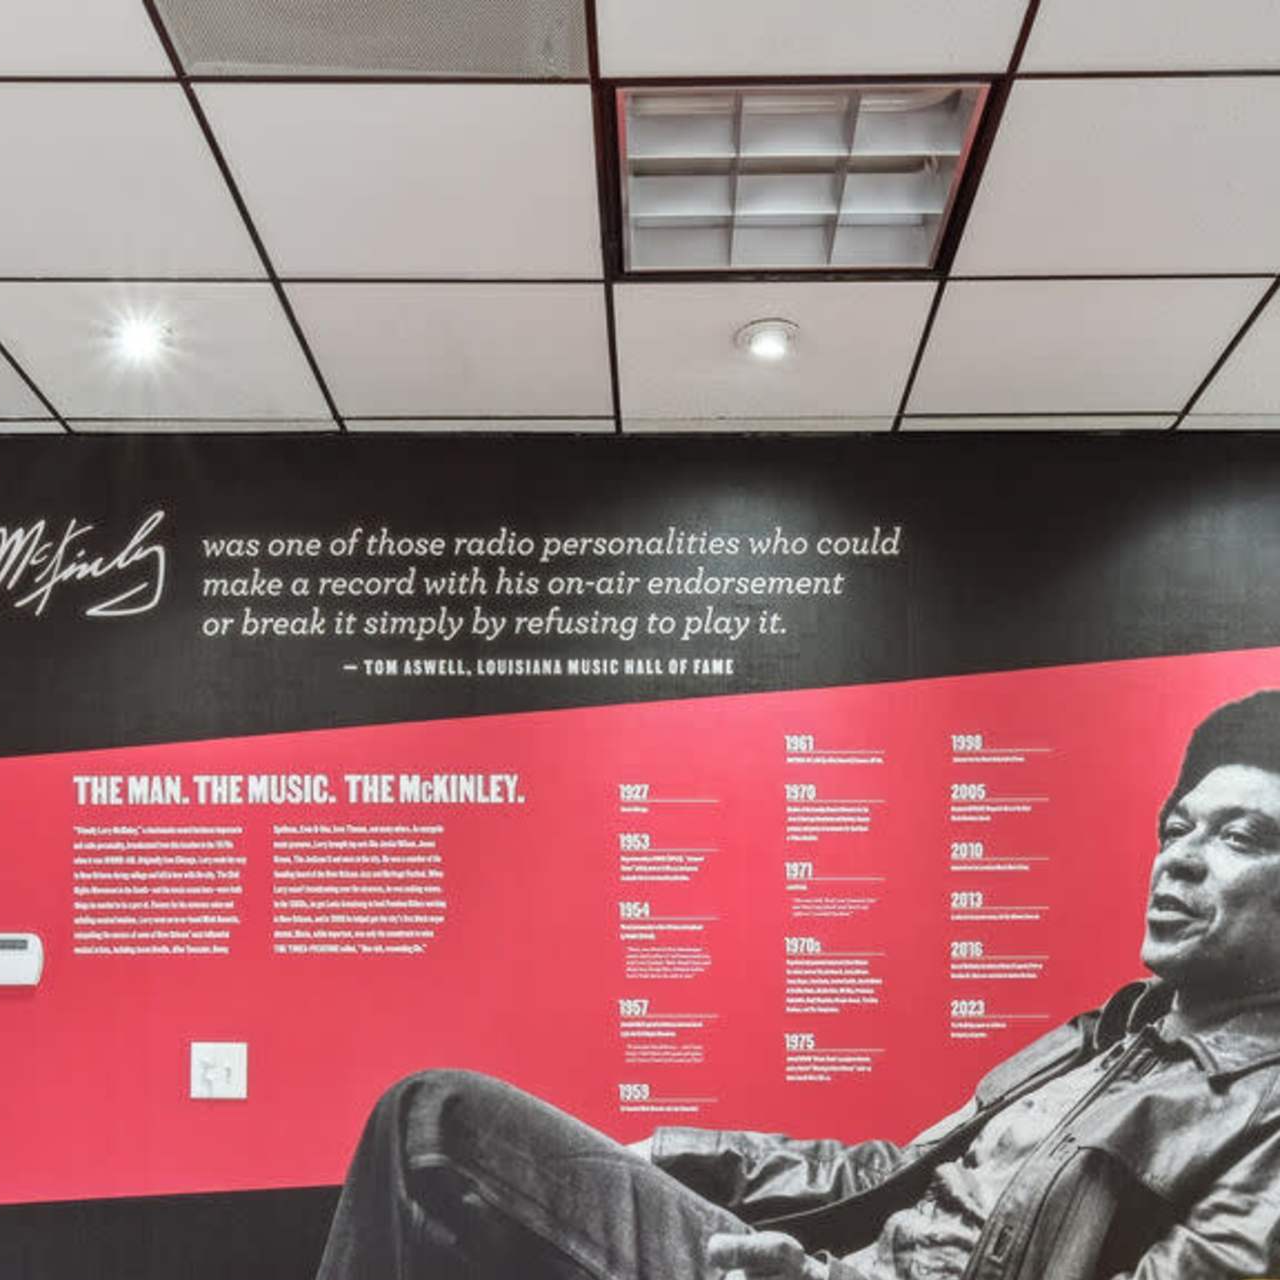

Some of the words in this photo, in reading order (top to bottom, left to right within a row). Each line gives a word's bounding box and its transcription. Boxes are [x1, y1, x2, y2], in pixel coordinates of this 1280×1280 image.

[203, 536, 259, 557] was
[268, 536, 321, 557] one
[329, 527, 364, 557] of
[366, 527, 447, 557] those
[454, 527, 535, 556] radio
[539, 527, 740, 562] personalities
[749, 527, 808, 556] who
[816, 527, 901, 556] could
[202, 567, 284, 597] make
[290, 576, 311, 597] a
[318, 567, 417, 597] record
[425, 567, 487, 596] with
[494, 567, 540, 596] his
[547, 570, 639, 596] on-air
[646, 567, 845, 596] endorsement
[202, 613, 235, 637] or
[241, 607, 326, 637] break
[333, 610, 357, 636] it
[363, 607, 463, 641] simply
[471, 606, 507, 641] by
[514, 606, 639, 641] refusing
[646, 611, 677, 635] to
[680, 606, 750, 641] play
[757, 609, 788, 636] it.
[363, 659, 399, 676] TOM
[403, 659, 473, 678] ASWELL,
[476, 658, 562, 675] LOUISIANA
[567, 658, 619, 675] MUSIC
[623, 658, 664, 675] HALL
[668, 658, 689, 675] OF
[692, 658, 735, 675] FAME
[73, 776, 123, 805] THE
[127, 775, 190, 805] MAN.
[192, 775, 244, 804] THE
[247, 774, 337, 804] MUSIC.
[345, 774, 395, 803] THE
[399, 774, 526, 803] McKINLEY.
[619, 784, 650, 800] 1927
[784, 784, 817, 800] 1970
[950, 784, 986, 799] 2005
[619, 833, 650, 850] 1953
[950, 842, 984, 859] 2010
[784, 862, 813, 879] 1971
[619, 902, 650, 918] 1954
[619, 999, 650, 1016] 1957
[950, 1000, 986, 1017] 2023
[784, 1032, 816, 1050] 1975
